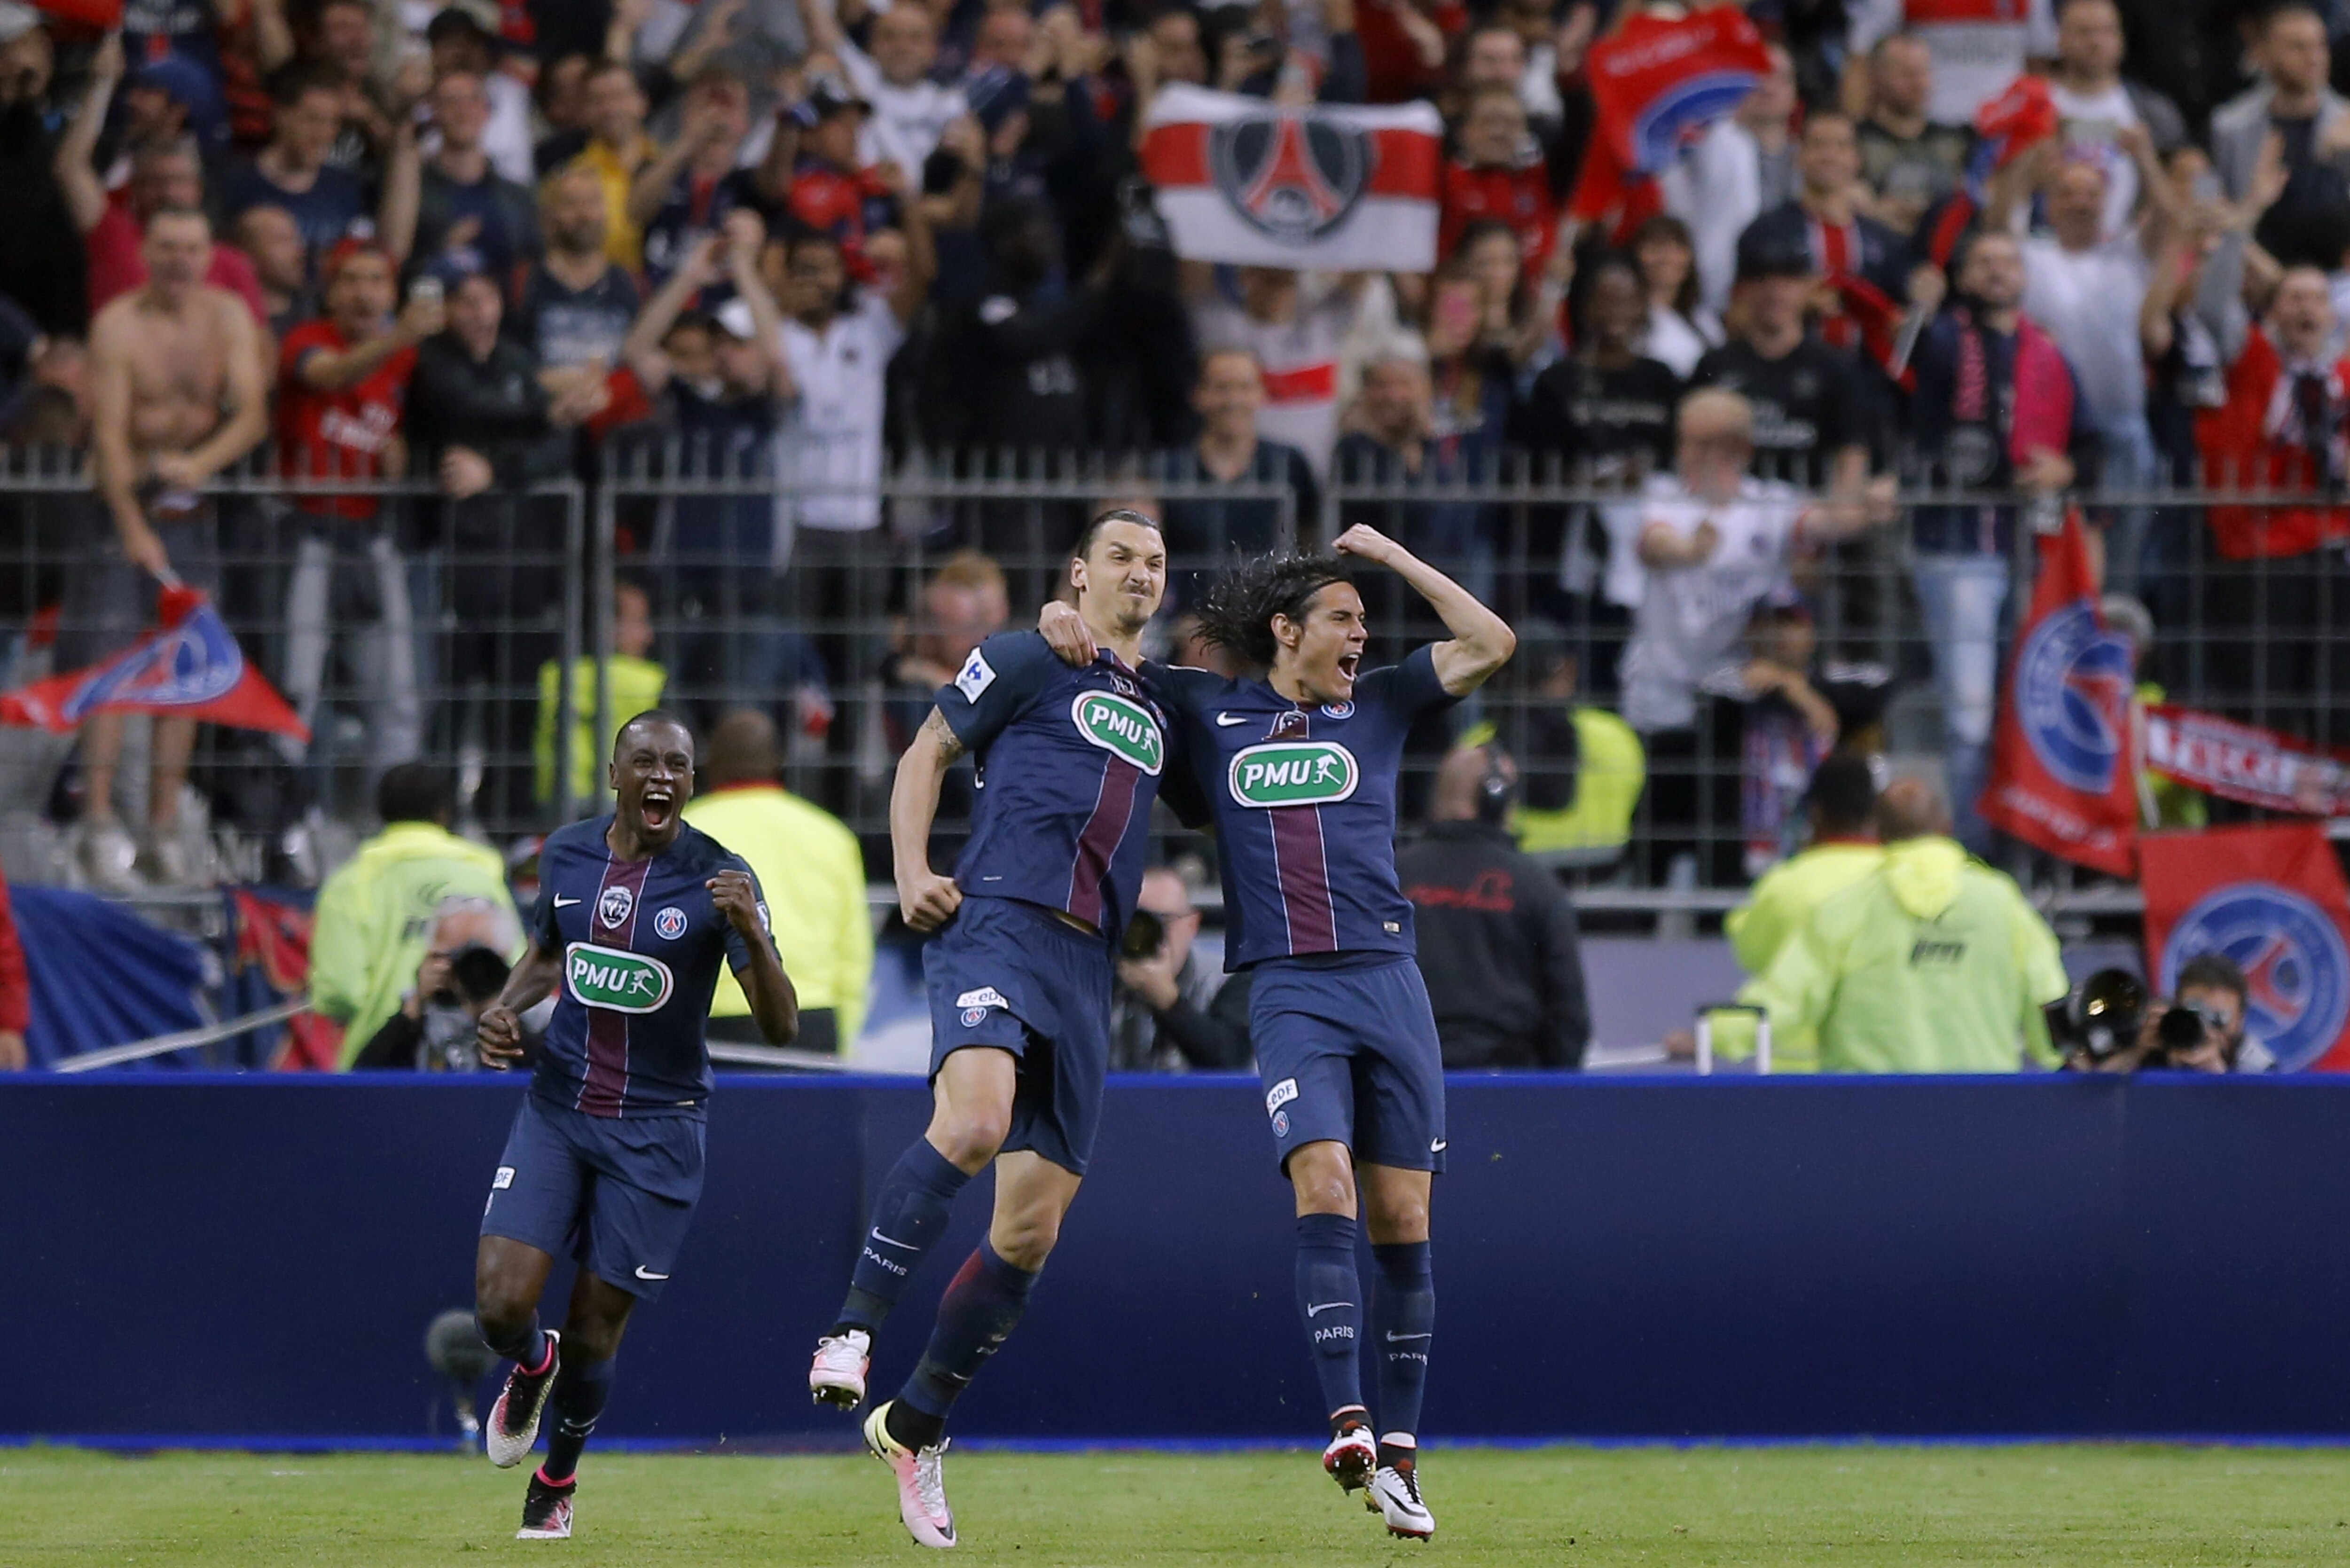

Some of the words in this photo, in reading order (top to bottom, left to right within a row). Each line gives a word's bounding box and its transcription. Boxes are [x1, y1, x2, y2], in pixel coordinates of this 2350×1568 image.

[1091, 704, 1142, 744] PMU
[1244, 759, 1312, 790] PMU
[573, 957, 628, 992] PMU
[864, 1247, 907, 1276] PARIS
[1315, 1325, 1354, 1343] PARIS
